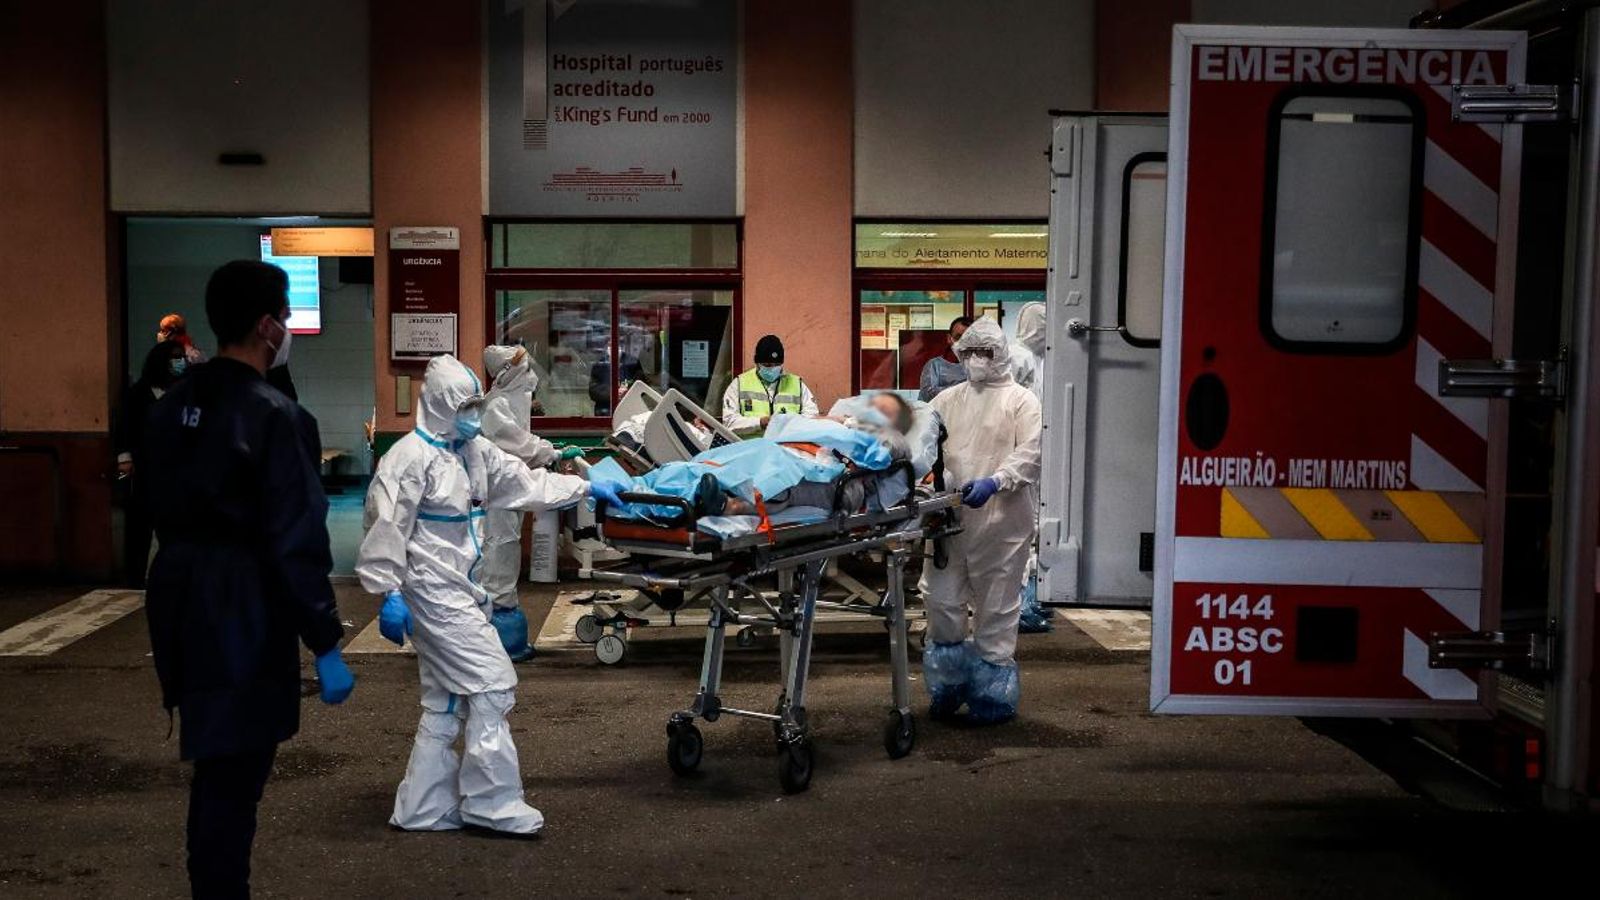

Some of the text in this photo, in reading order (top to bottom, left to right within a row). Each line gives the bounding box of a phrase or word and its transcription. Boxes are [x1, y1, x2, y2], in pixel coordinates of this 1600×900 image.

[552, 54, 724, 75] Hospital português
[1199, 40, 1497, 86] EMERGÊNCIA
[553, 80, 655, 97] acreditado
[563, 106, 612, 126] King's
[617, 107, 659, 123] Fund
[663, 114, 680, 123] em
[682, 112, 711, 124] 2000
[402, 257, 442, 265] URGÊNCIA
[914, 247, 990, 258] Aleitamento
[994, 248, 1047, 258] Materno
[1180, 451, 1276, 487] ALGUEIRÃO
[1288, 458, 1326, 487] MEM
[1330, 459, 1407, 489] MARTINS
[1195, 593, 1275, 620] 1144
[1184, 626, 1284, 653] ABSC
[1213, 659, 1252, 686] 01
